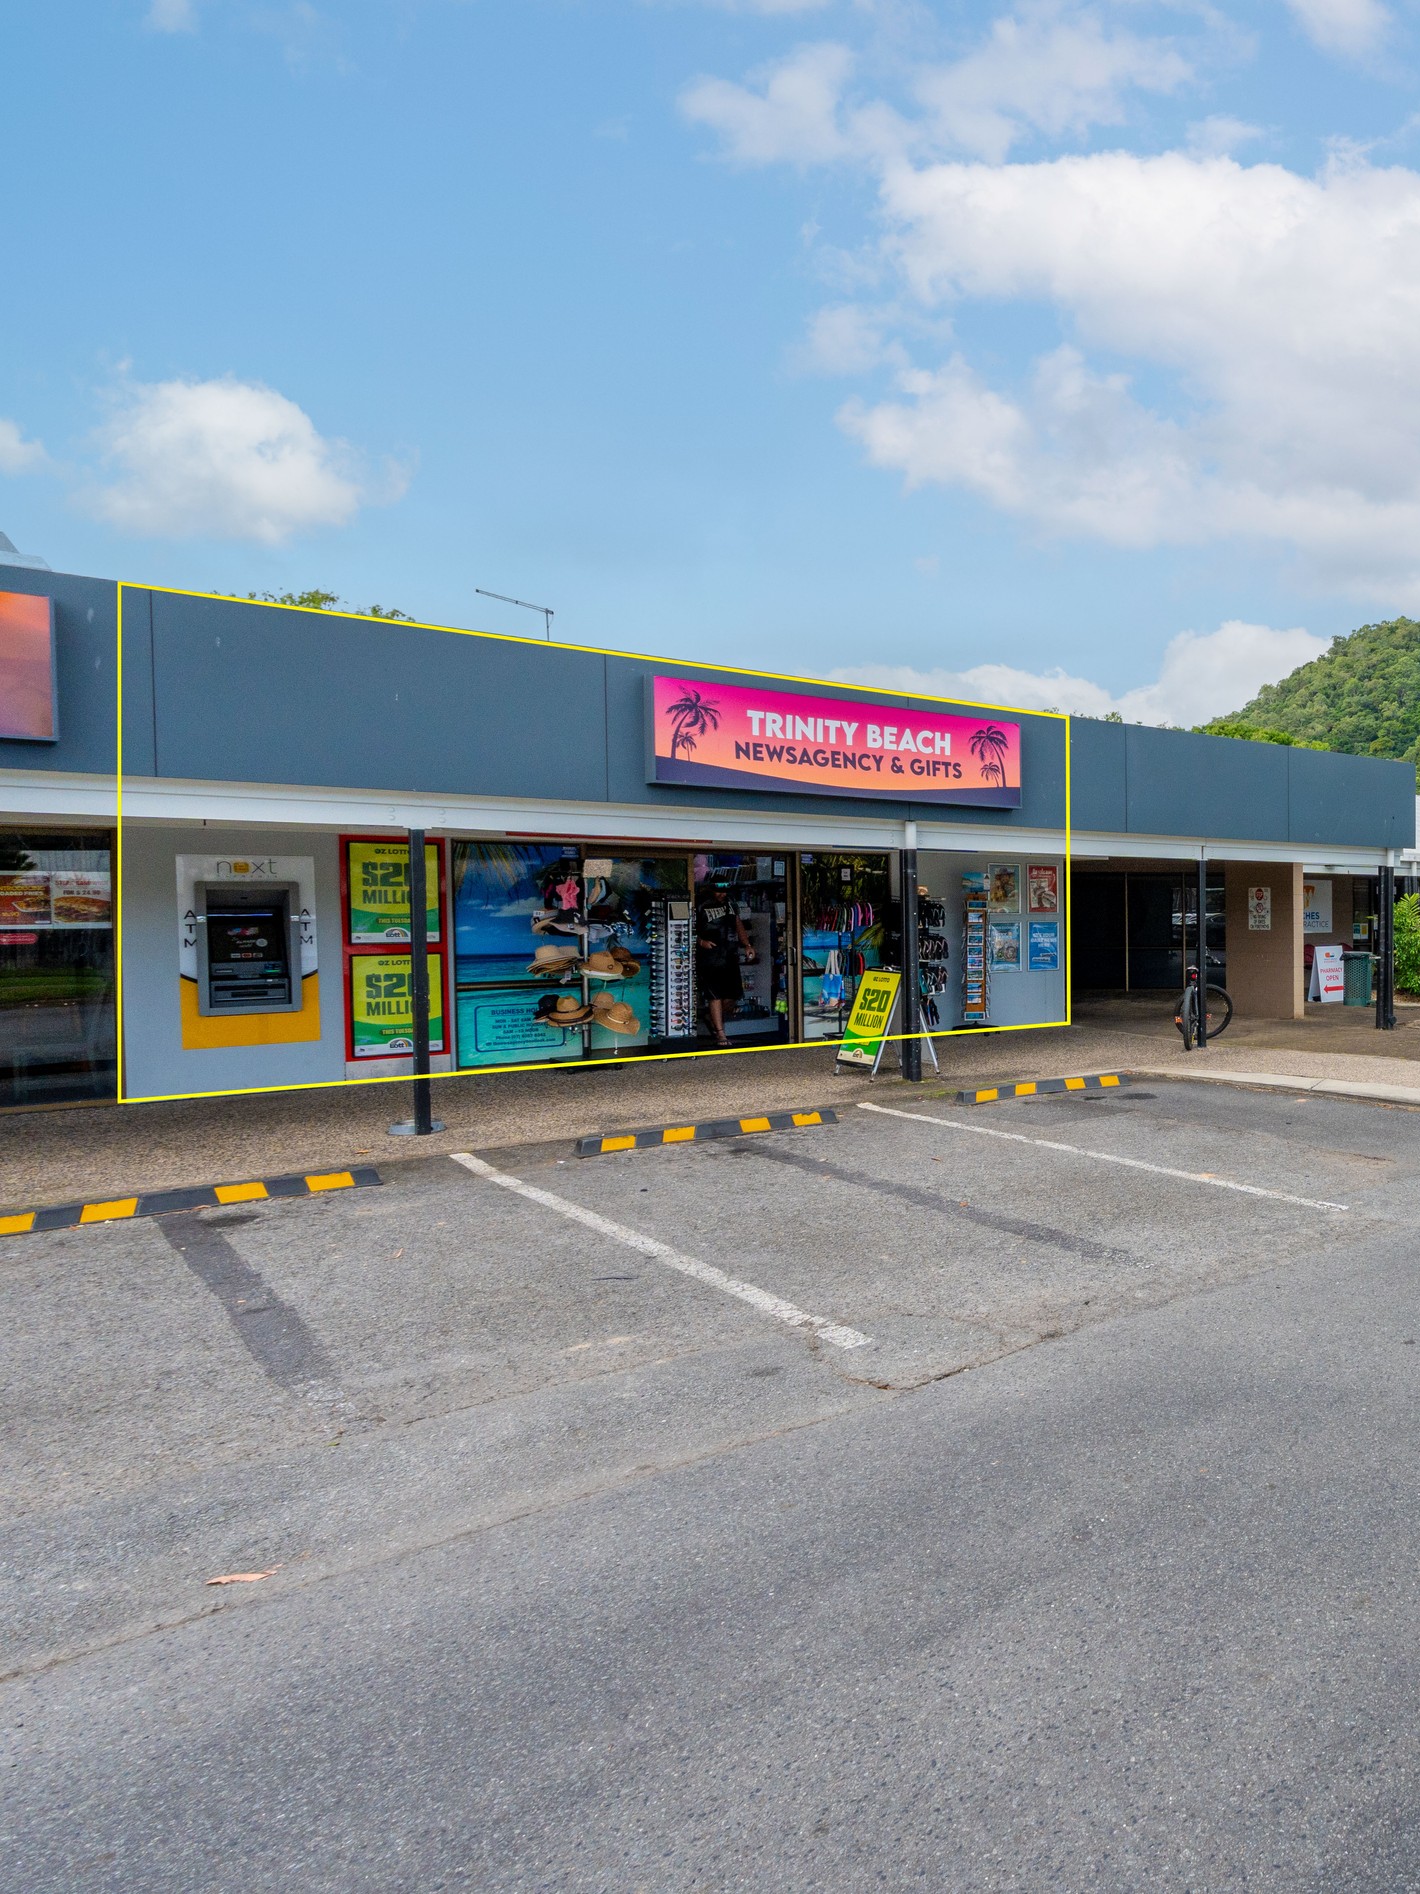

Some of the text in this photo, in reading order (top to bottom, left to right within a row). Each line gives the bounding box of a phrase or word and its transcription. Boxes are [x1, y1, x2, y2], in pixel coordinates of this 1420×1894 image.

[747, 709, 951, 756] TRINITY BEACH
[734, 740, 963, 779] NEWSAGENCY & GIFTS
[362, 889, 411, 904] MILLI
[184, 910, 197, 948] ATM
[300, 908, 313, 945] ATM
[366, 1000, 412, 1016] MILLI
[491, 1008, 525, 1016] BUSINESS
[859, 987, 892, 1013] $20
[854, 1012, 884, 1029] MILLION
